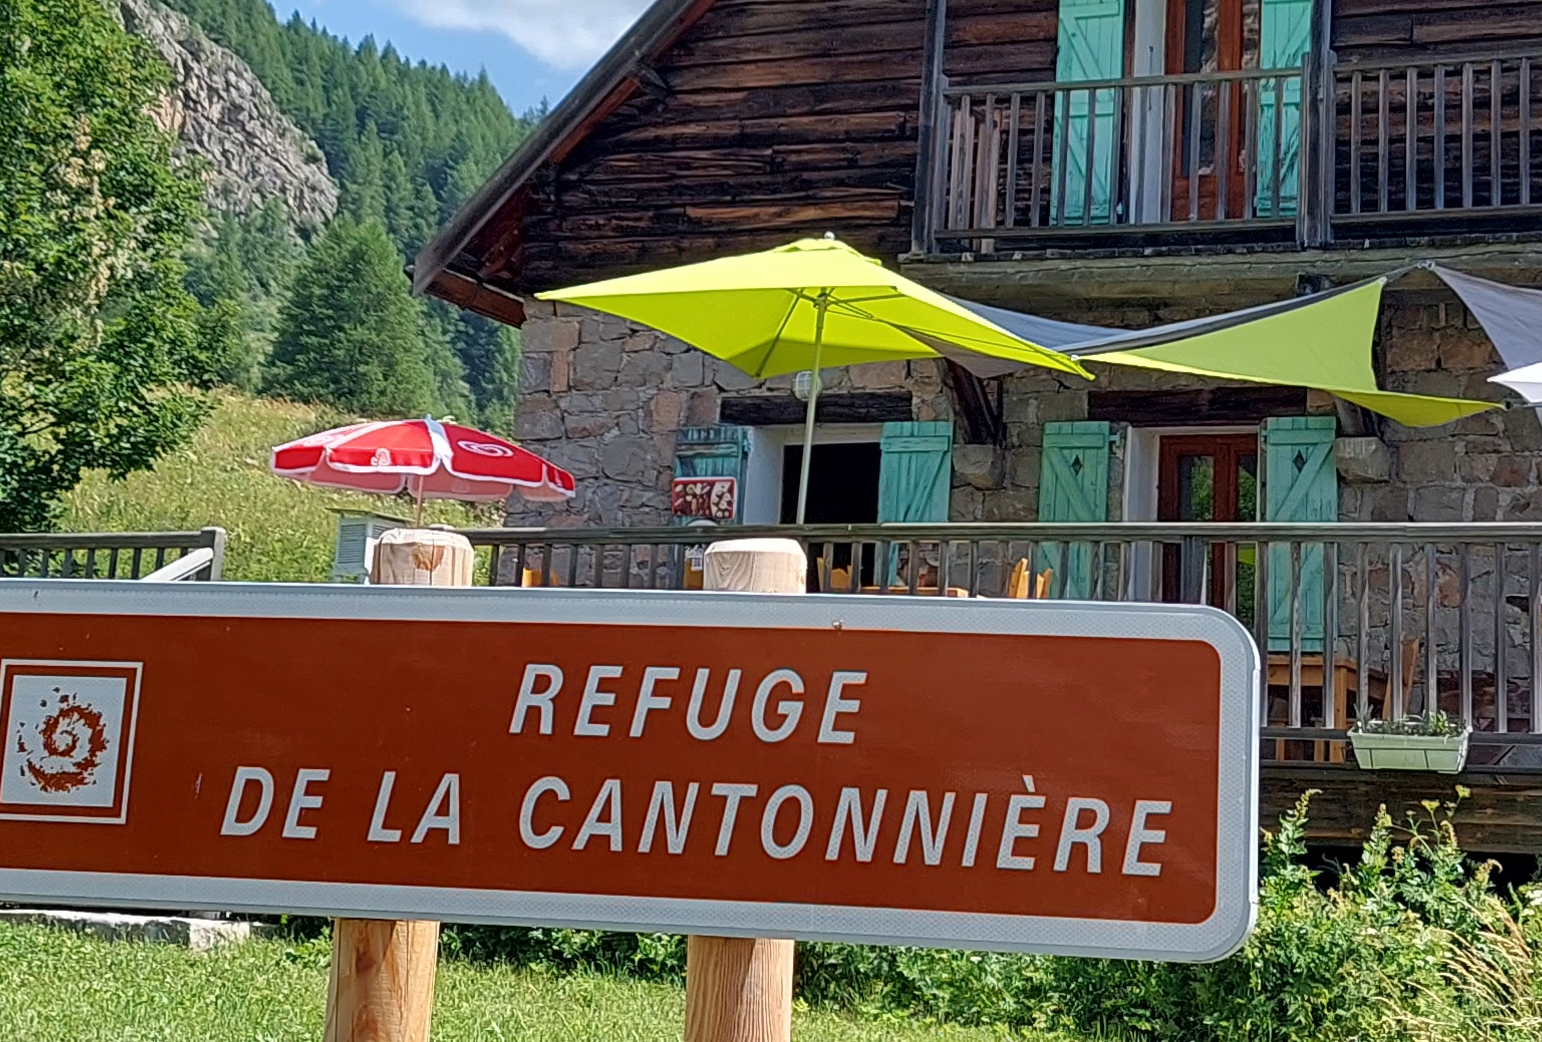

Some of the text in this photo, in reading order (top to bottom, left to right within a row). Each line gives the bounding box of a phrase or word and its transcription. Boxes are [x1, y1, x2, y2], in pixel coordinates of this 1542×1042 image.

[509, 663, 868, 744] REFUGE
[220, 766, 1172, 876] DE LA CANTONNIÈRE
